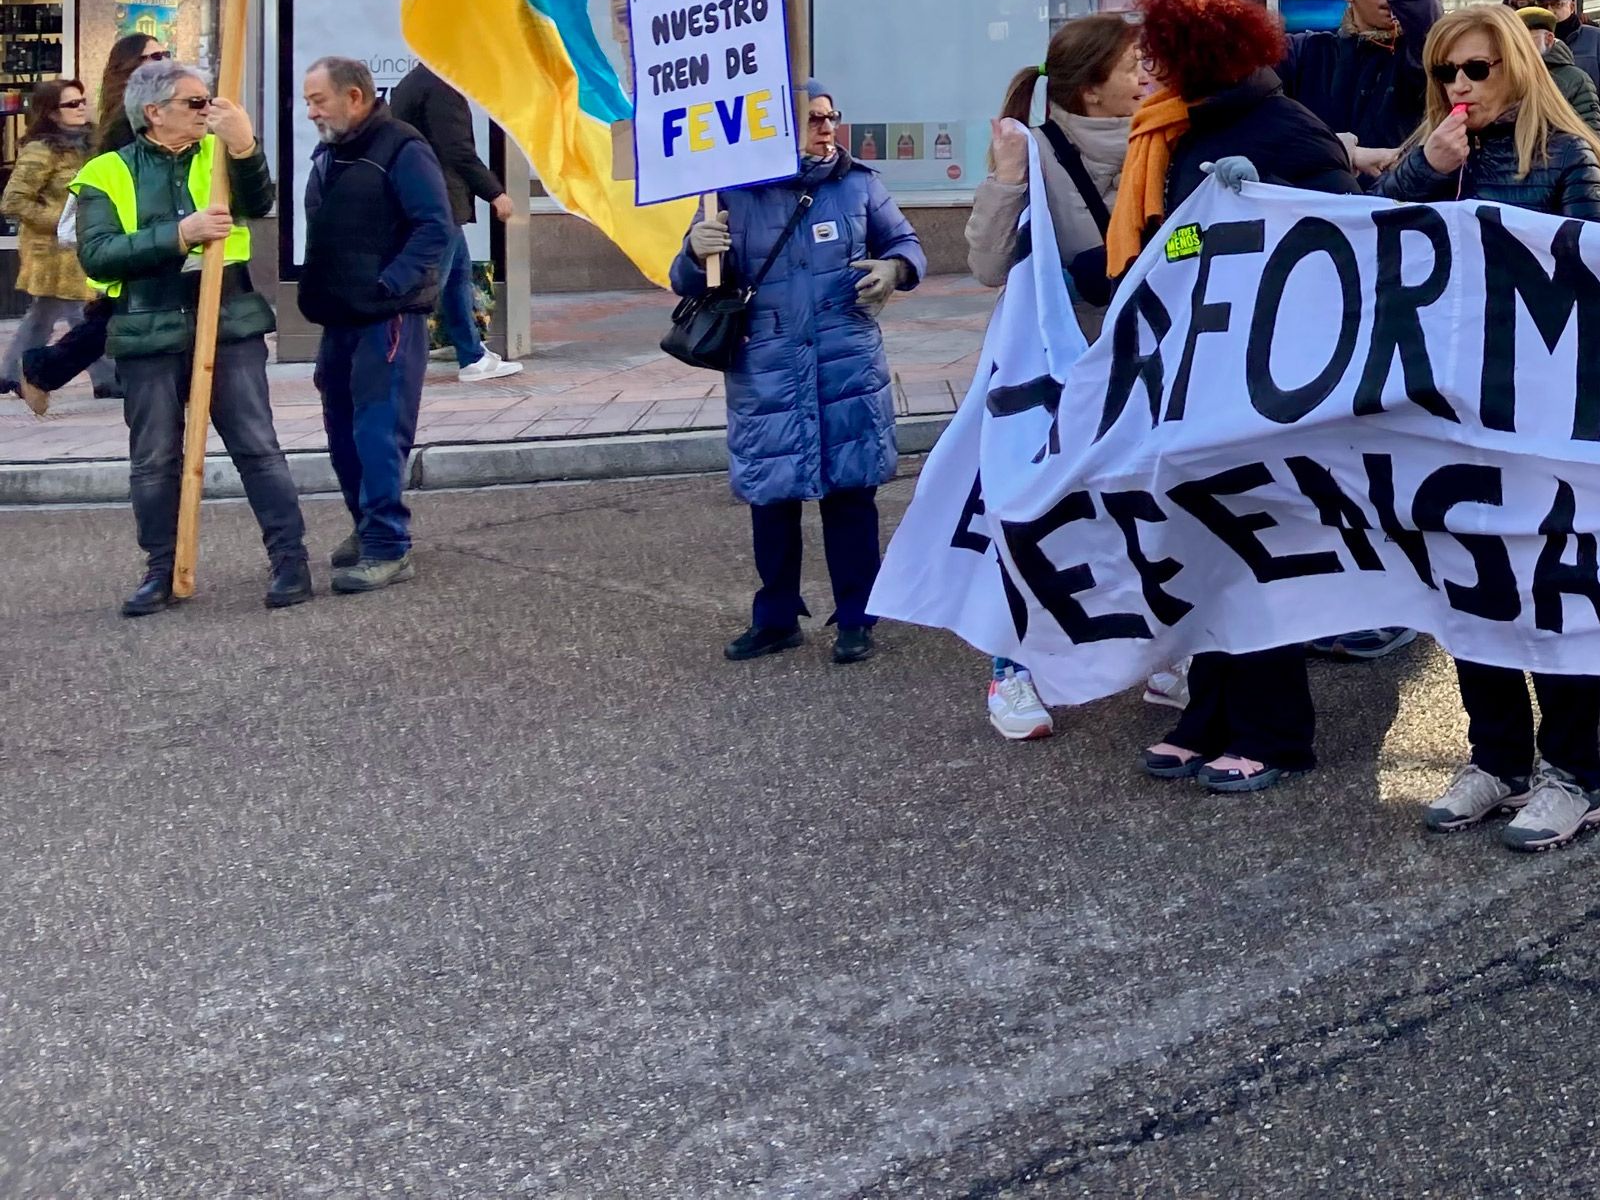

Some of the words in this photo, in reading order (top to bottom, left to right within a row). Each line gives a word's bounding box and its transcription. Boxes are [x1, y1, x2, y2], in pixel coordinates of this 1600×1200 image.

[648, 53, 710, 96] TREN
[725, 42, 759, 80] DE
[1166, 234, 1201, 251] MENOS
